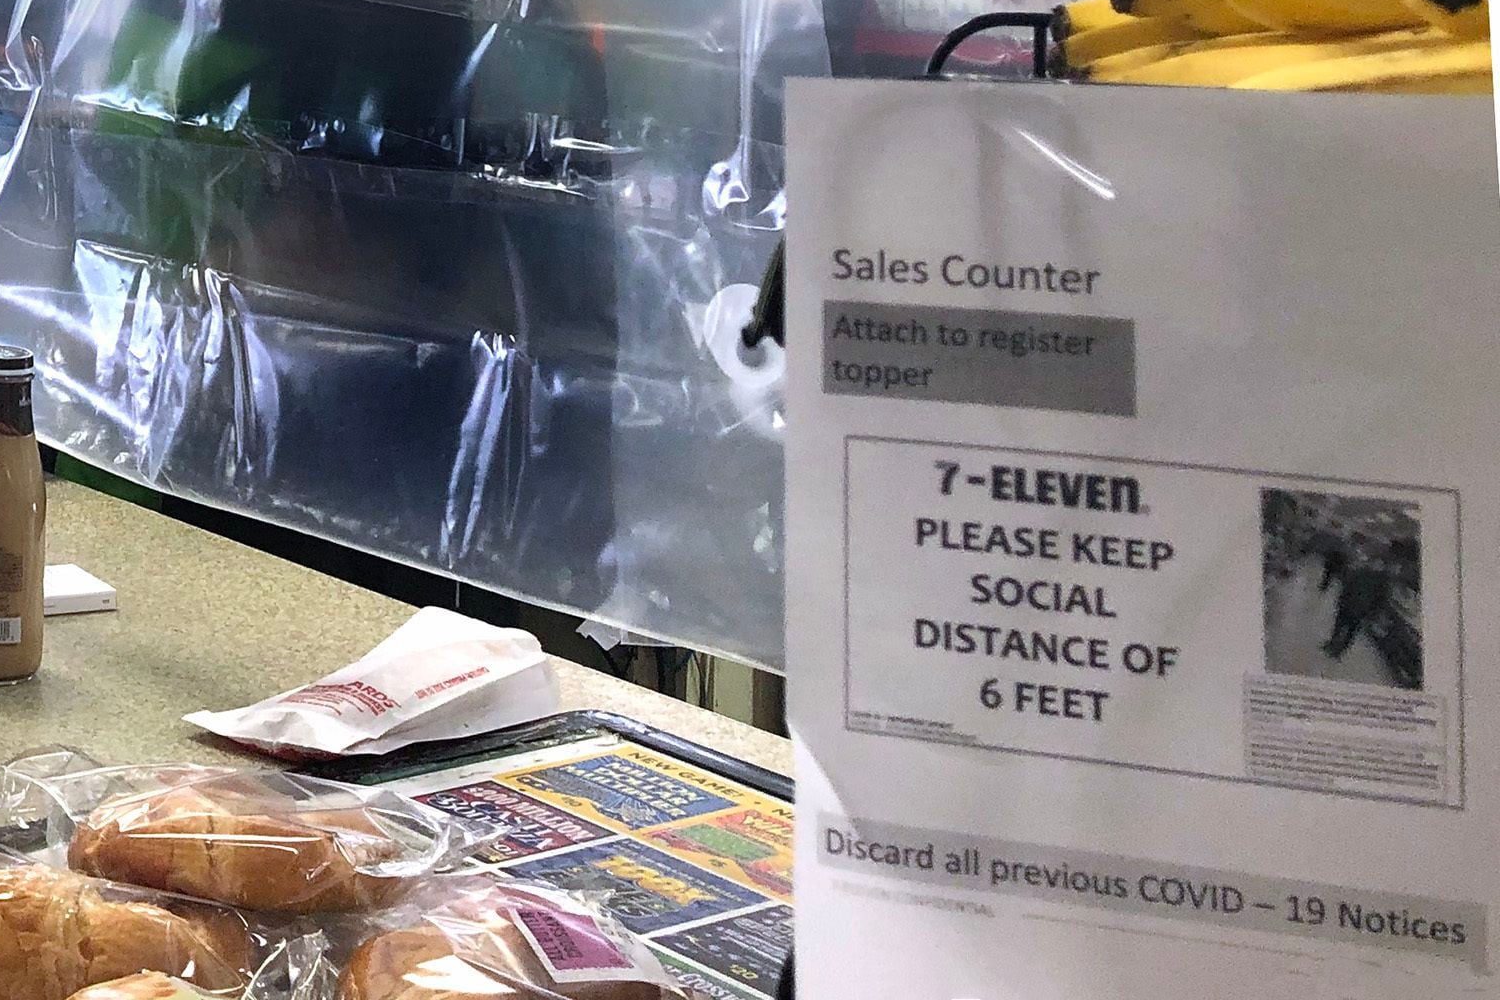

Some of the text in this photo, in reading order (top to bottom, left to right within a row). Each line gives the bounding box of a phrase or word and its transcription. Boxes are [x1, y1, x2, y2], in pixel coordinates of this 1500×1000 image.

[831, 248, 1101, 295] Sales Counter
[831, 315, 1096, 358] Attach to register
[831, 358, 933, 389] topper
[914, 517, 1175, 571] PLEASE KEEP
[970, 573, 1117, 618] SOCIAL
[913, 618, 1181, 677] DISTANCE OF
[979, 678, 1110, 722] 6 FEET
[629, 752, 743, 799] NEW GAME!
[507, 801, 597, 842] MILLION
[825, 827, 934, 871] Discard
[944, 845, 980, 876] all
[990, 857, 1129, 899] previous
[1137, 874, 1245, 914] COVID
[1286, 894, 1327, 926] 19
[1338, 902, 1467, 946] Notices
